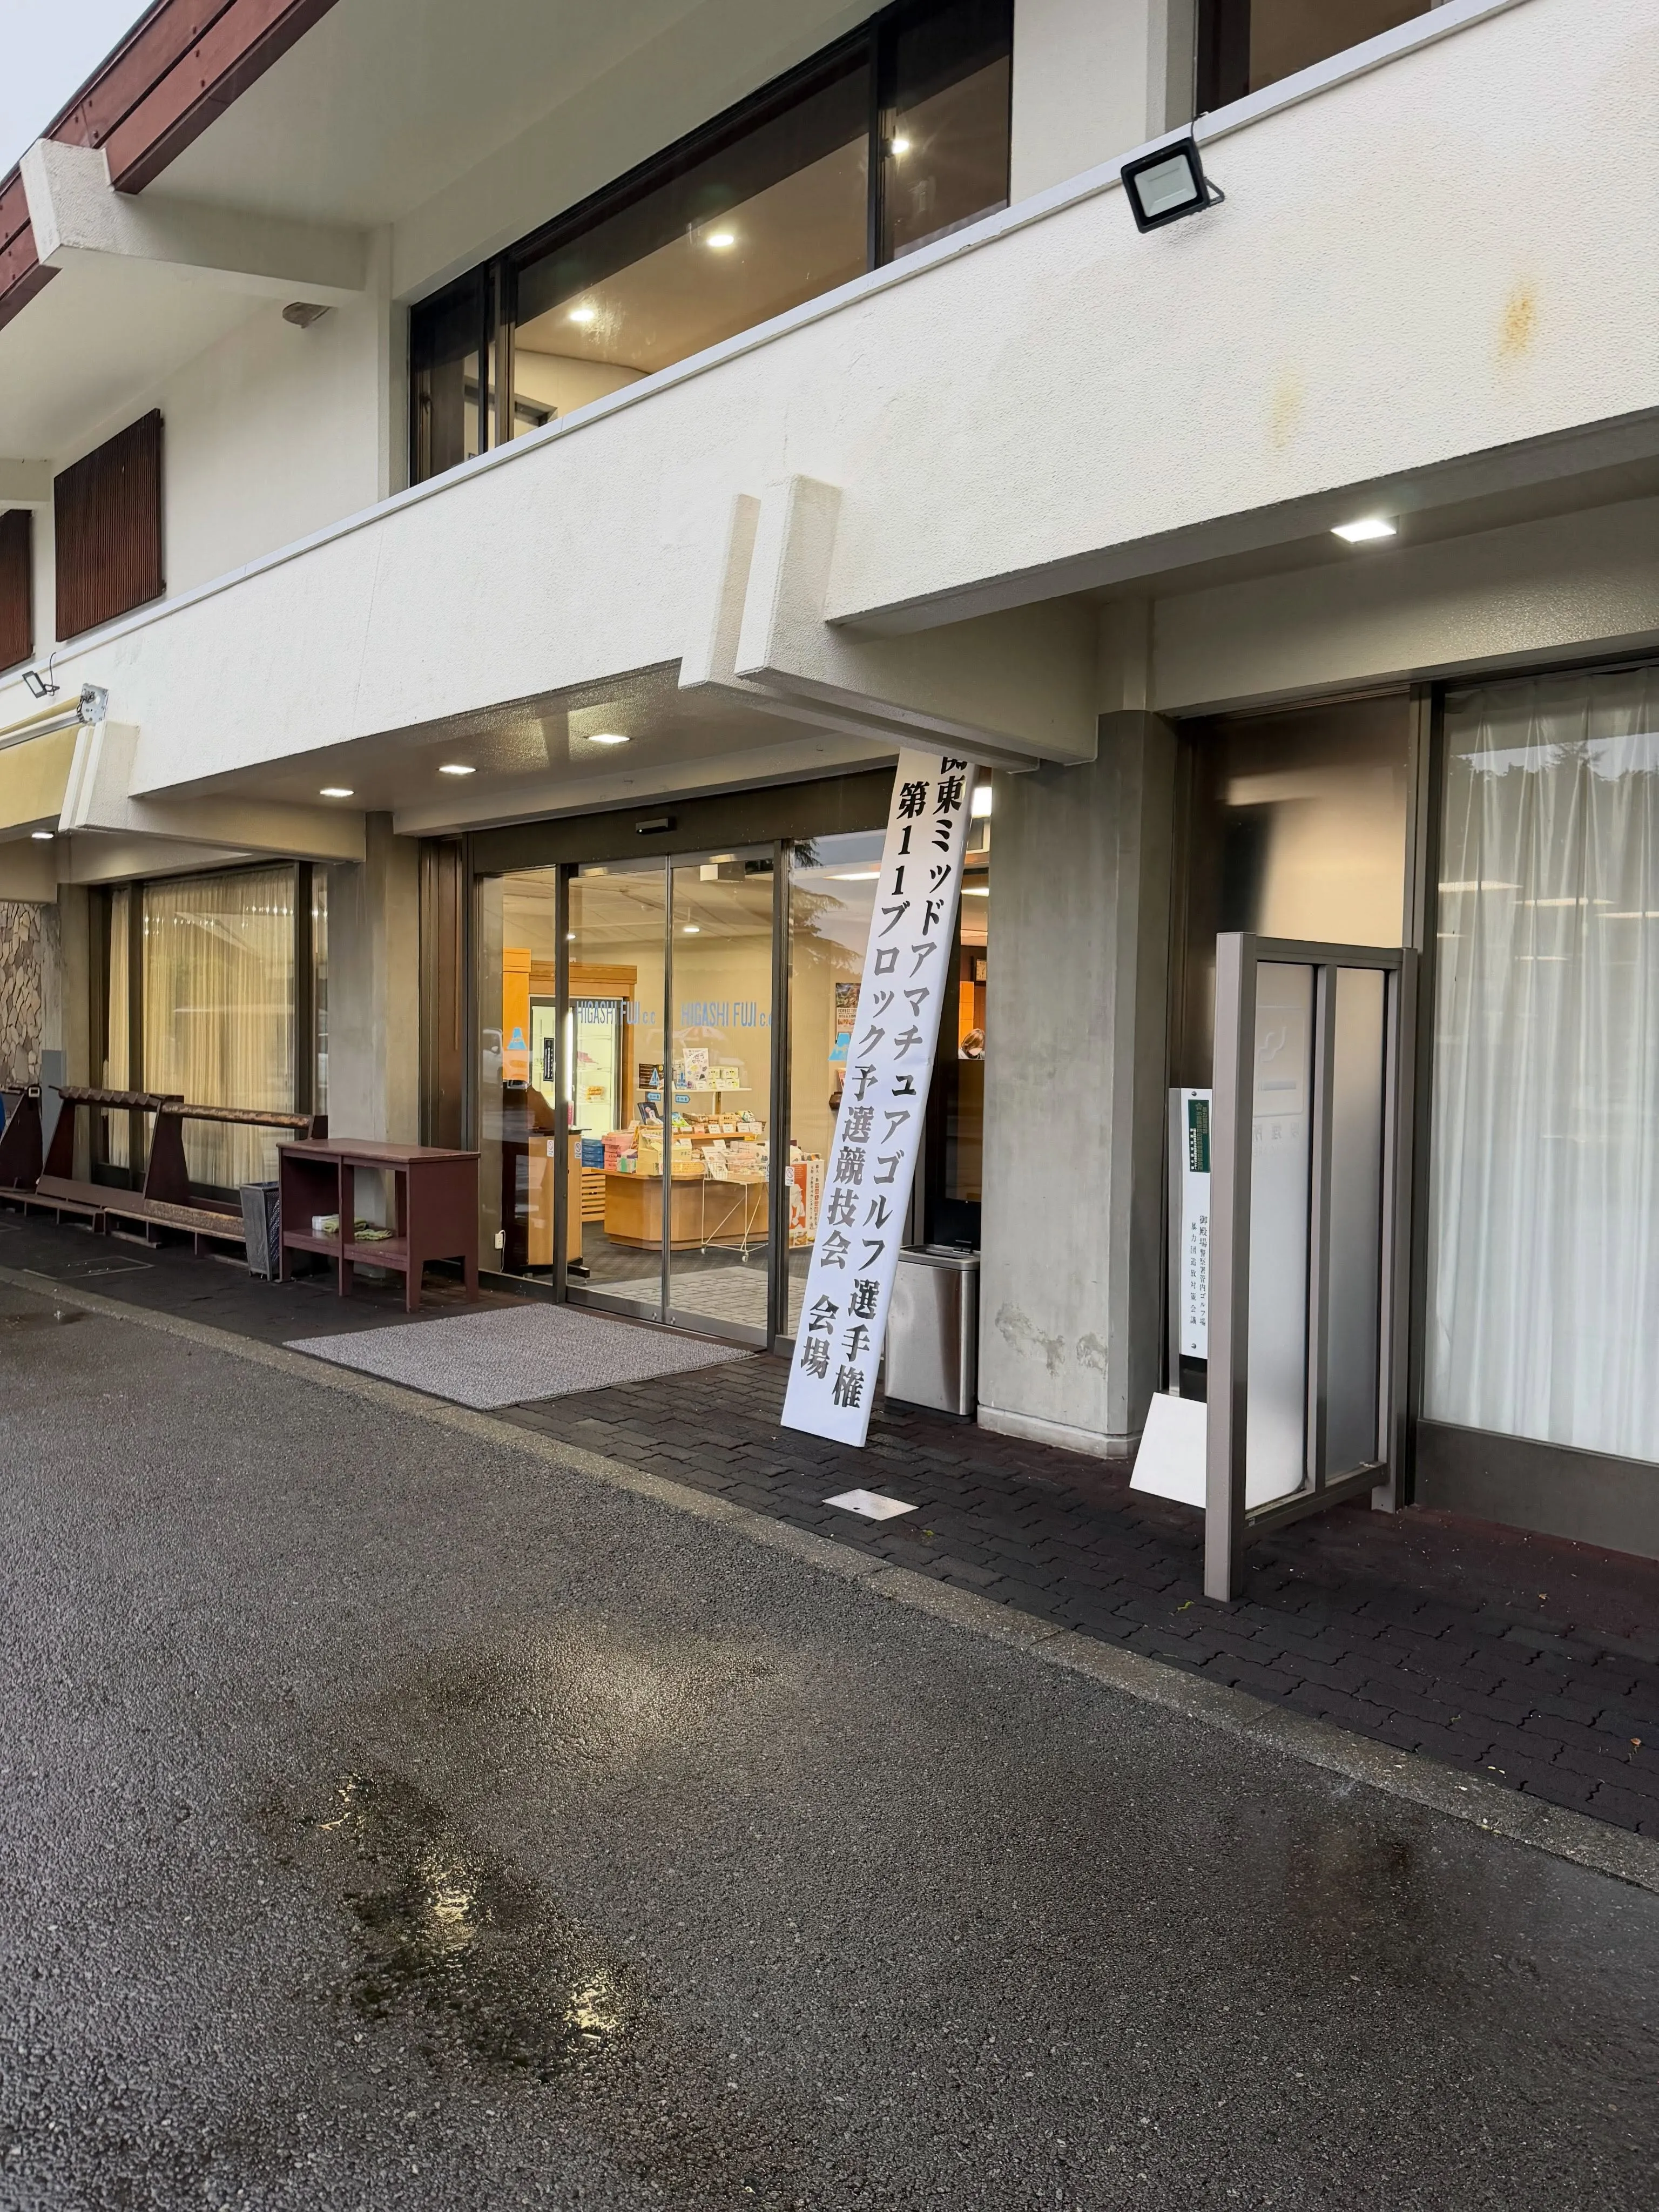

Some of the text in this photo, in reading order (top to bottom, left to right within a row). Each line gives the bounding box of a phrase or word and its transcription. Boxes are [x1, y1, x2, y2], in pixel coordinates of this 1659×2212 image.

[576, 1001, 617, 1024] HIGASHI
[621, 1001, 640, 1024] FUJI
[682, 1001, 729, 1027] HIGASHI
[733, 1002, 756, 1027] FUJI
[800, 1294, 840, 1379] 会場
